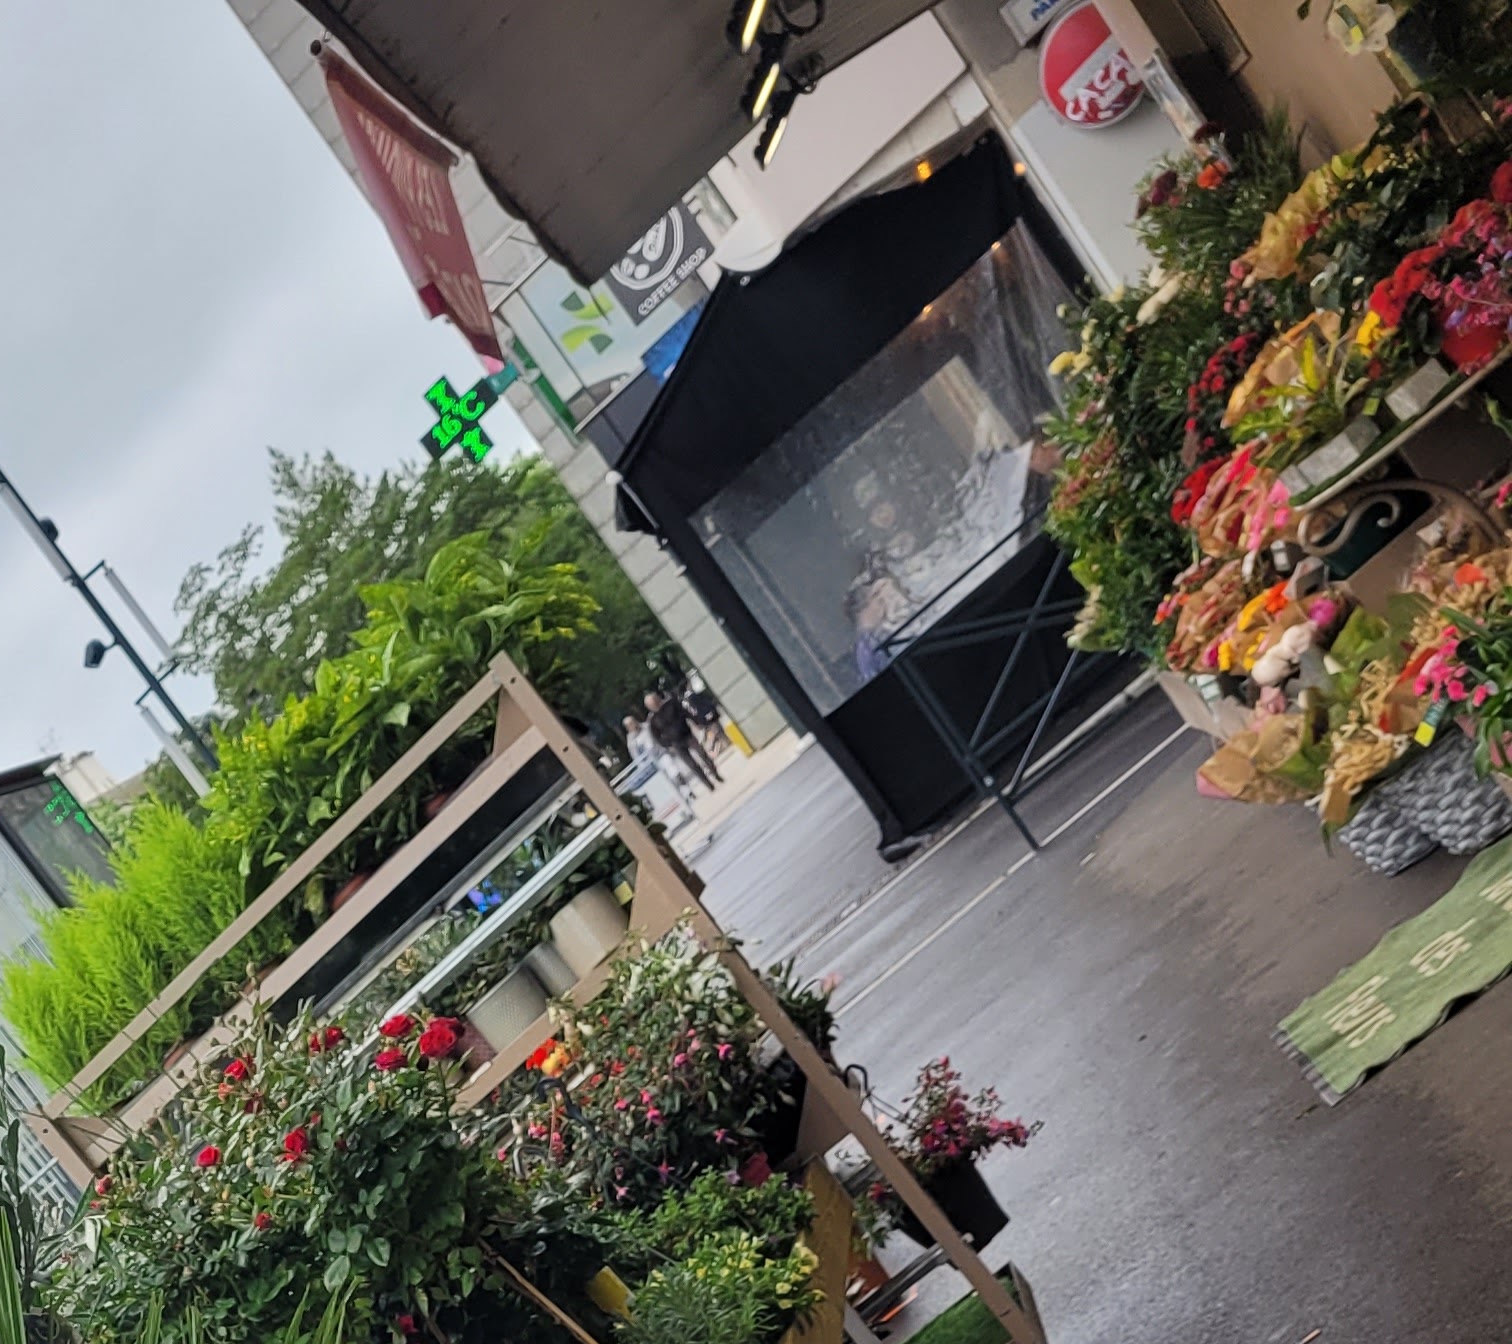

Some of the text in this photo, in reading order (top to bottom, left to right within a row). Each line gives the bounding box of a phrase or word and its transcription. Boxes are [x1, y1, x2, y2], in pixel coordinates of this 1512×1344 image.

[637, 247, 707, 316] COFFEE SHOP
[1409, 916, 1478, 977] des
